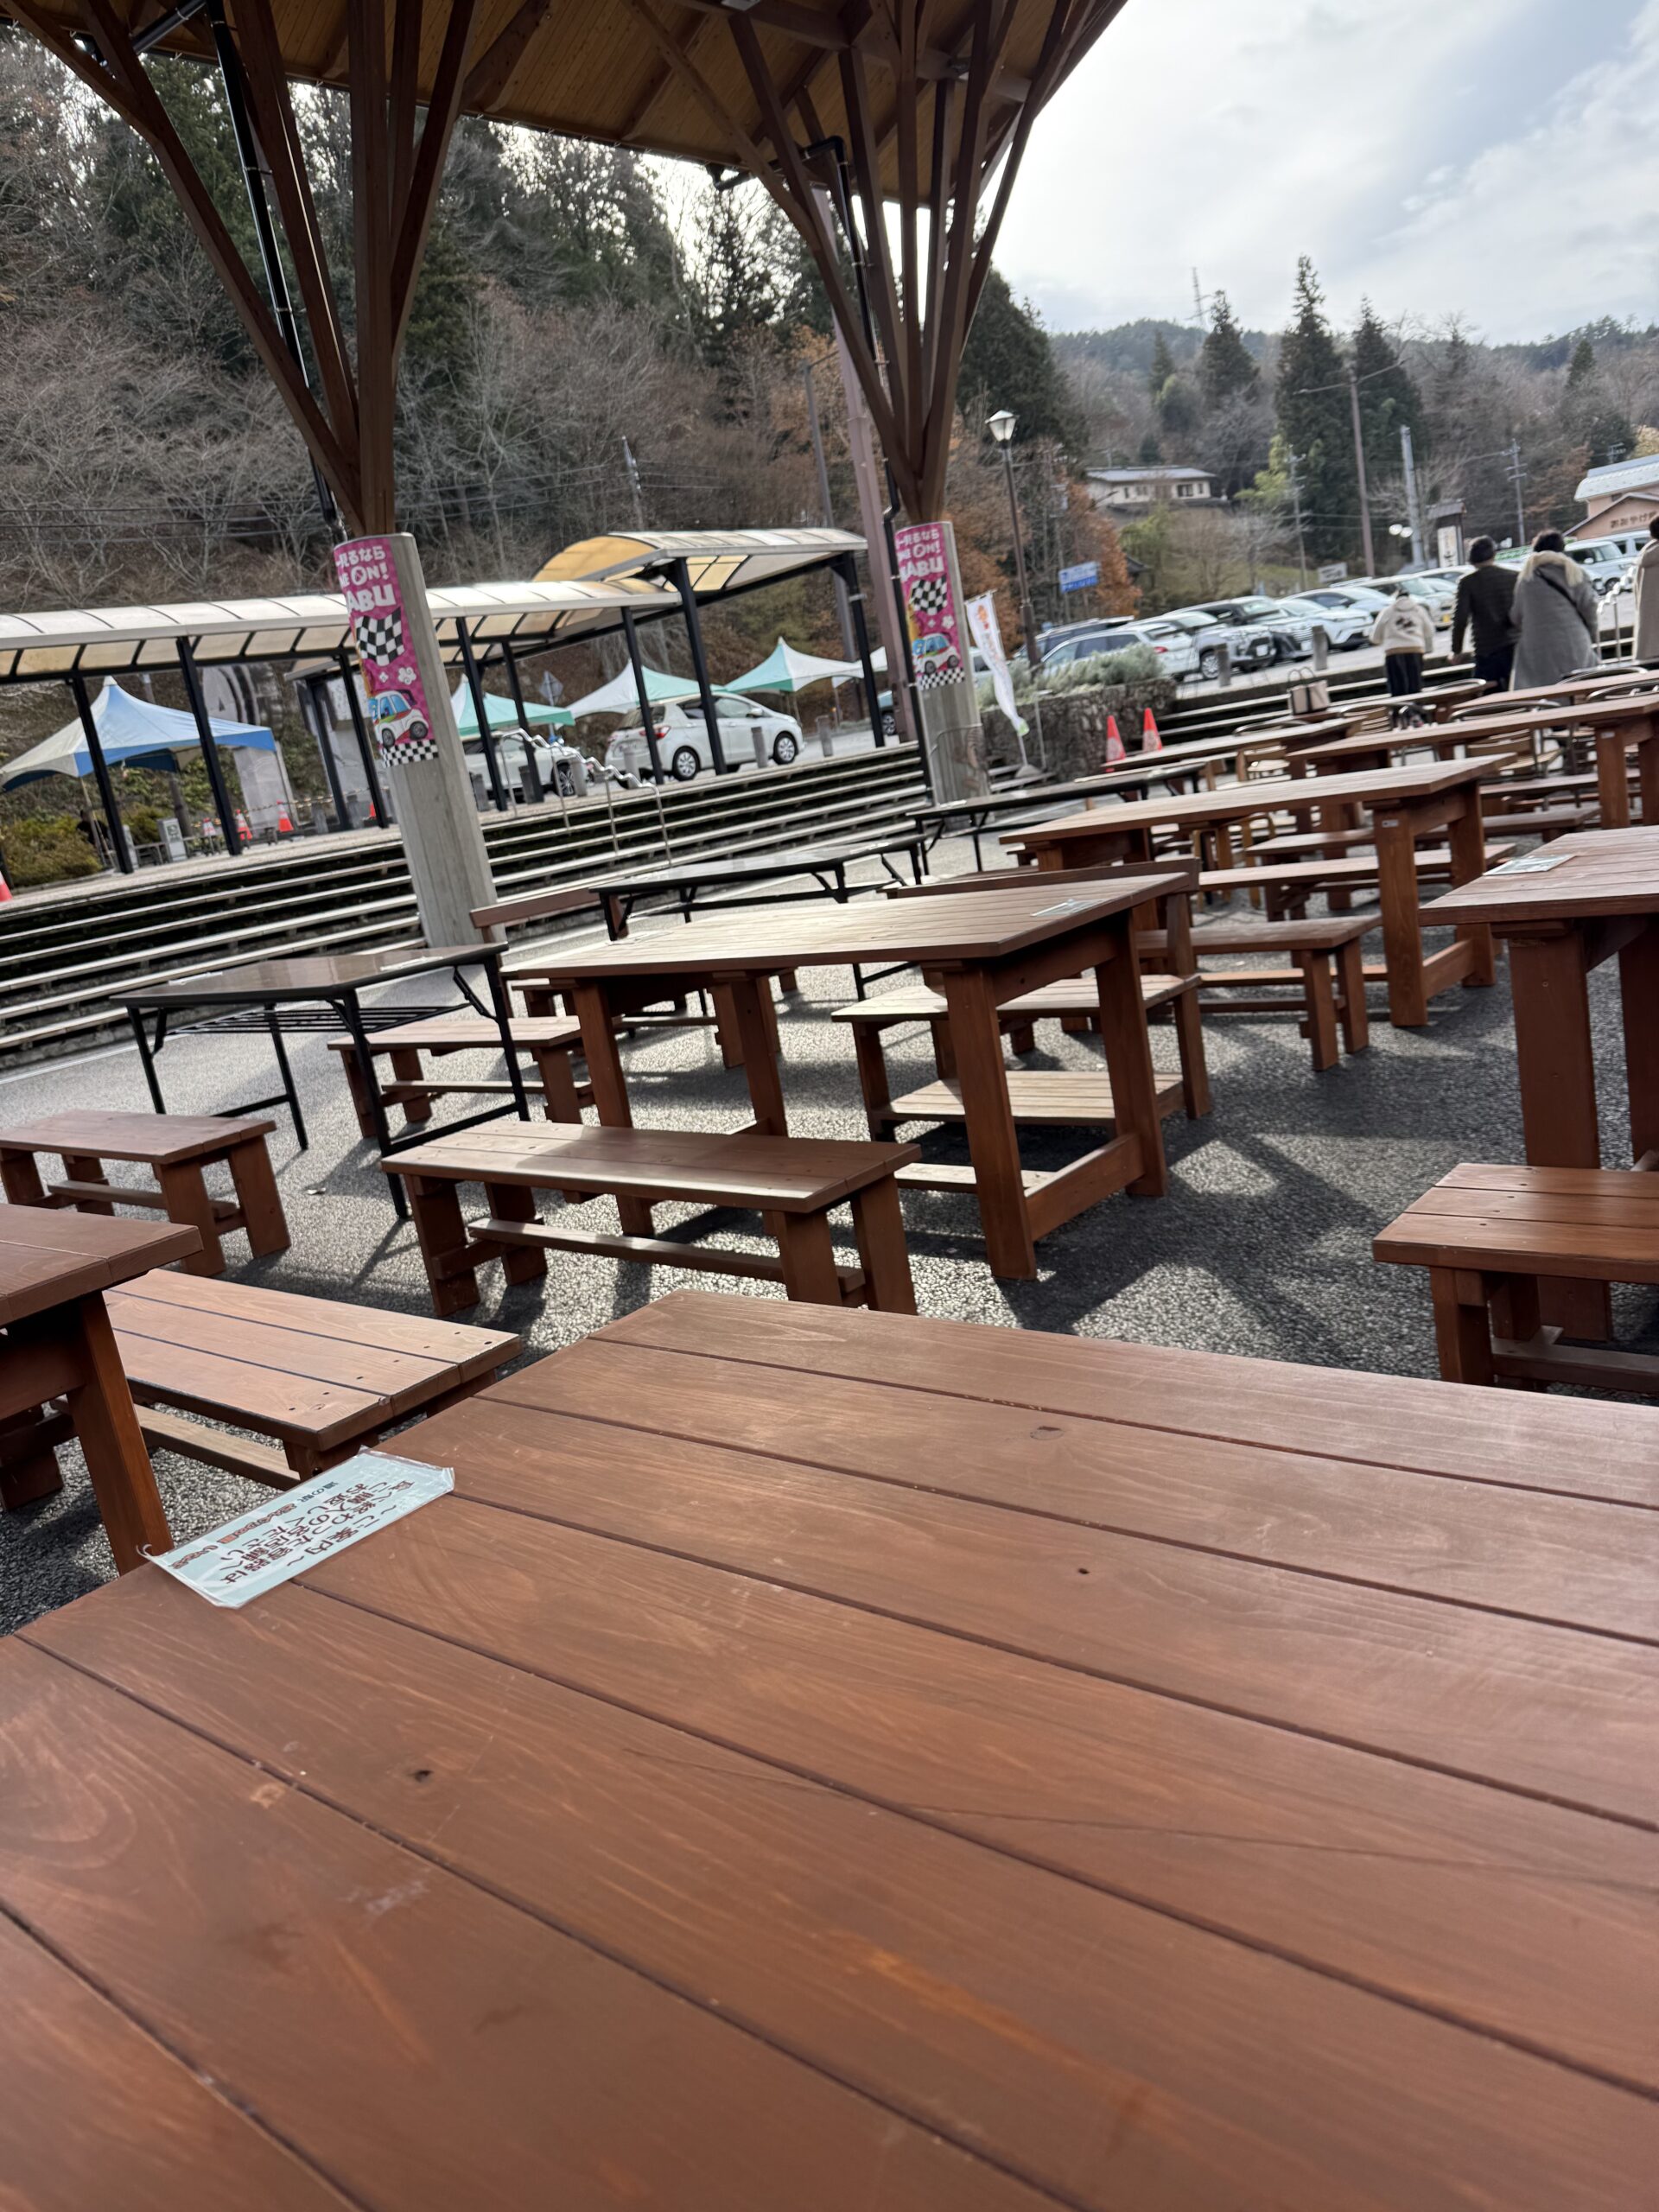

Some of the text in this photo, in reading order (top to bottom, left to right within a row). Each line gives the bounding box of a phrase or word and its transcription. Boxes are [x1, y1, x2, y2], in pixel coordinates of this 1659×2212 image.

[220, 1483, 368, 1560] お返しください
